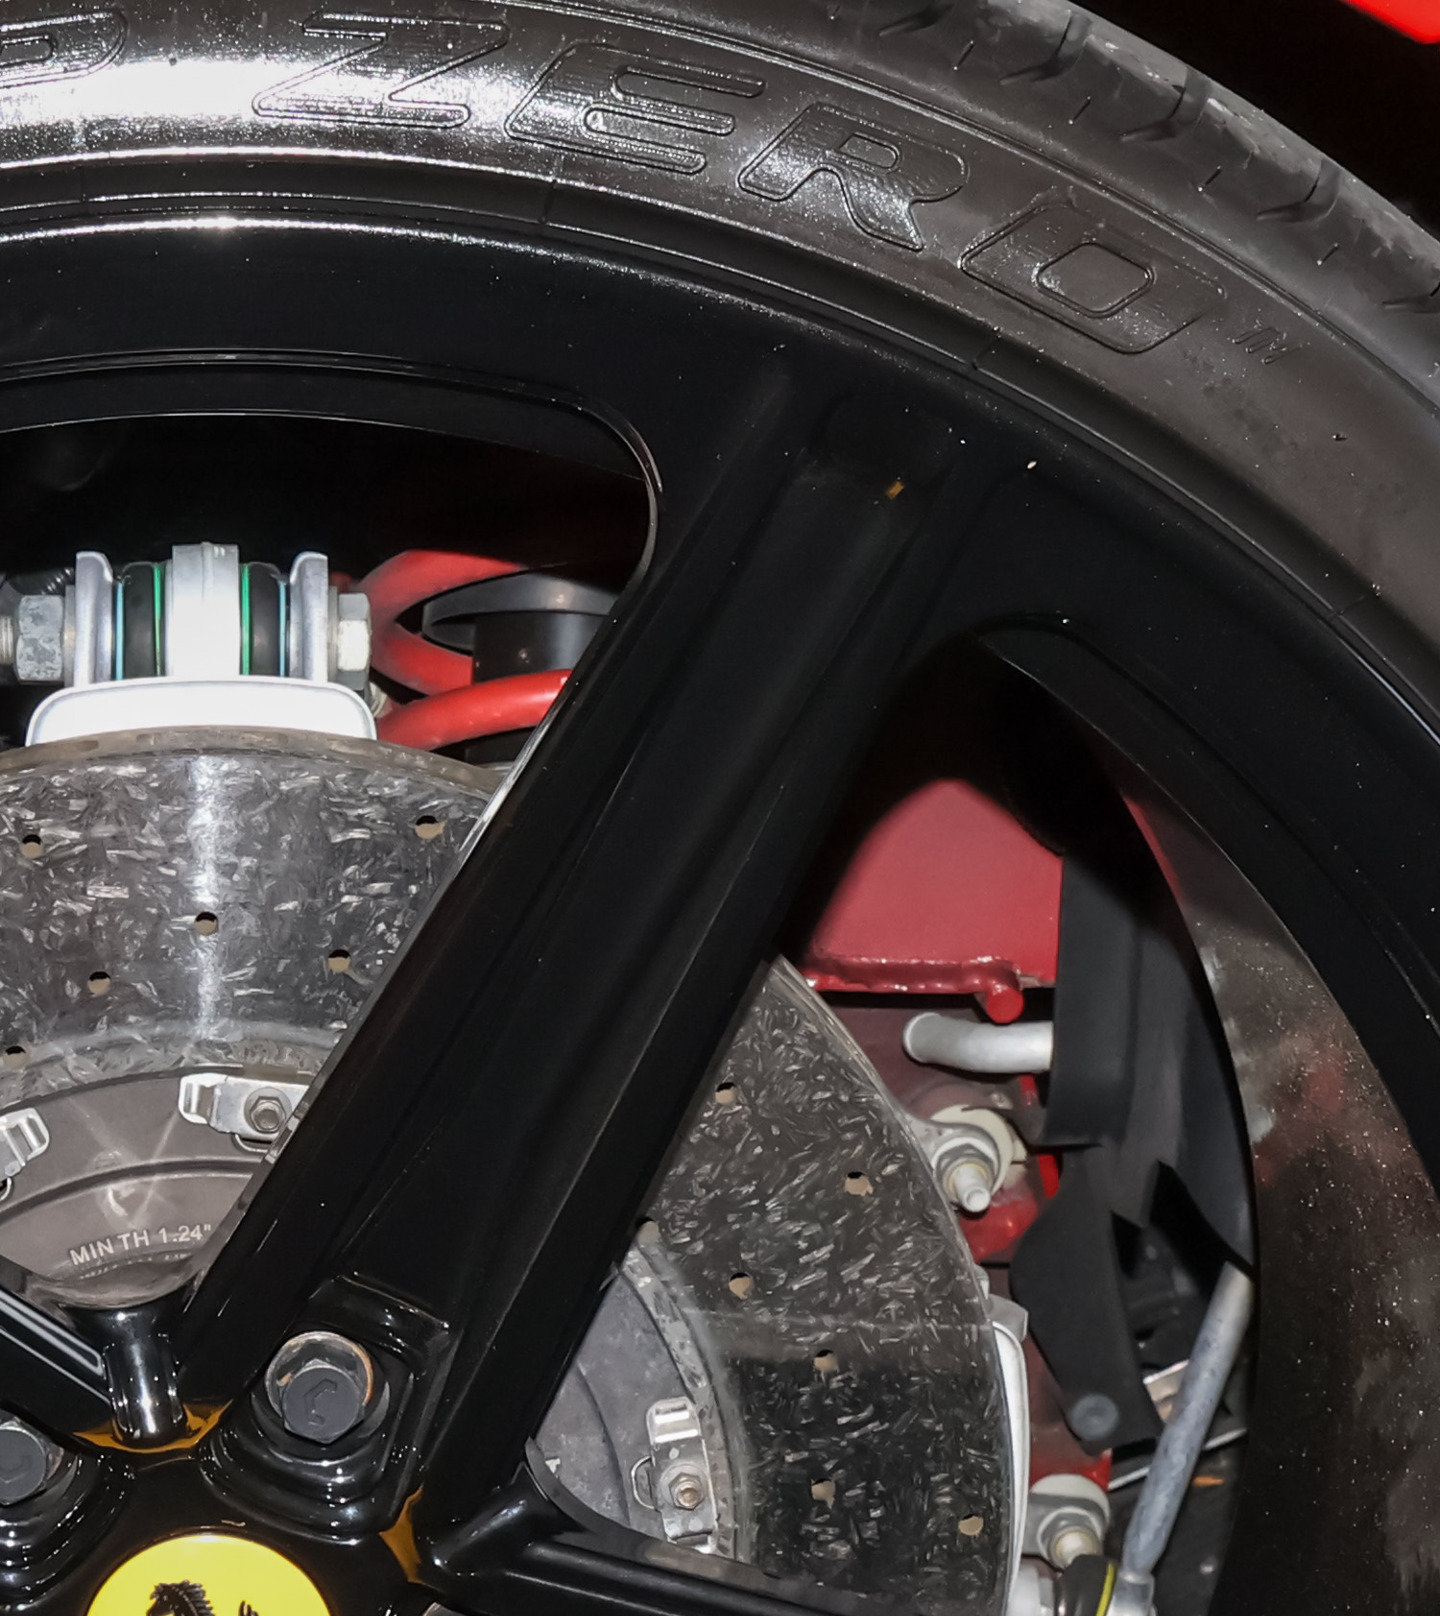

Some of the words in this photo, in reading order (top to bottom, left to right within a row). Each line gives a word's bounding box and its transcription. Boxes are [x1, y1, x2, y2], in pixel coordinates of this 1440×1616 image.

[250, 8, 1228, 356] ZERO
[69, 1238, 114, 1265] MIN
[117, 1229, 150, 1251] TH
[158, 1223, 212, 1244] 1.24"
